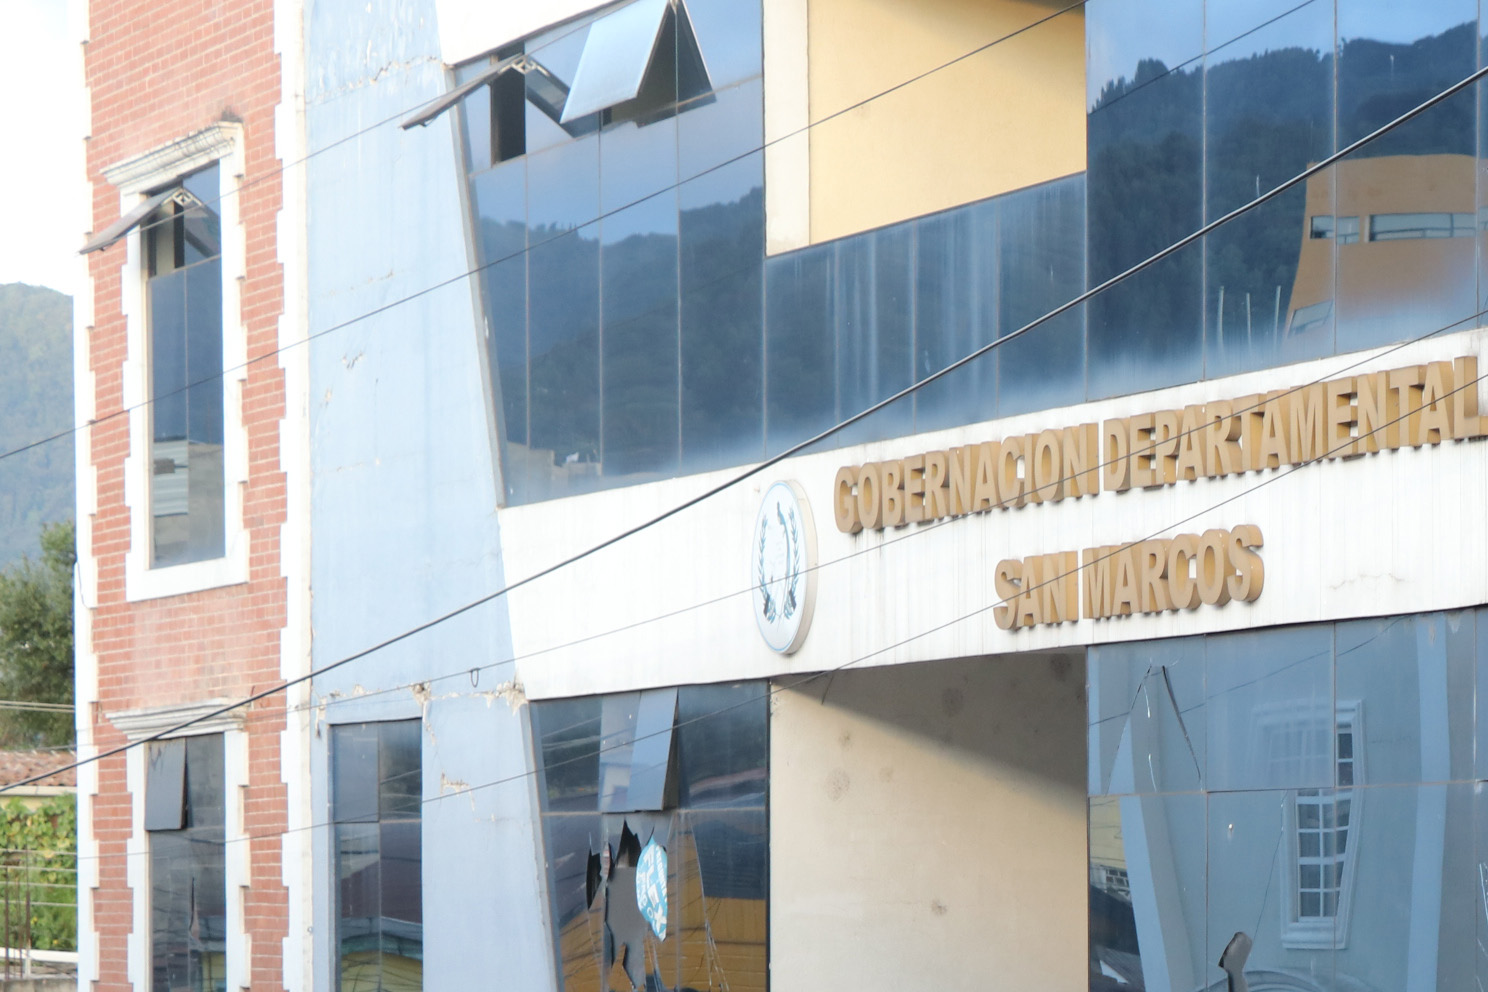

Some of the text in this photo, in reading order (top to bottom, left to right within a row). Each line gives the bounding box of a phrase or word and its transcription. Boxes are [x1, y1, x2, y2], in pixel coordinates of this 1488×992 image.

[833, 423, 1099, 534] GOBERNACION
[994, 523, 1264, 631] SAN MARCOS
